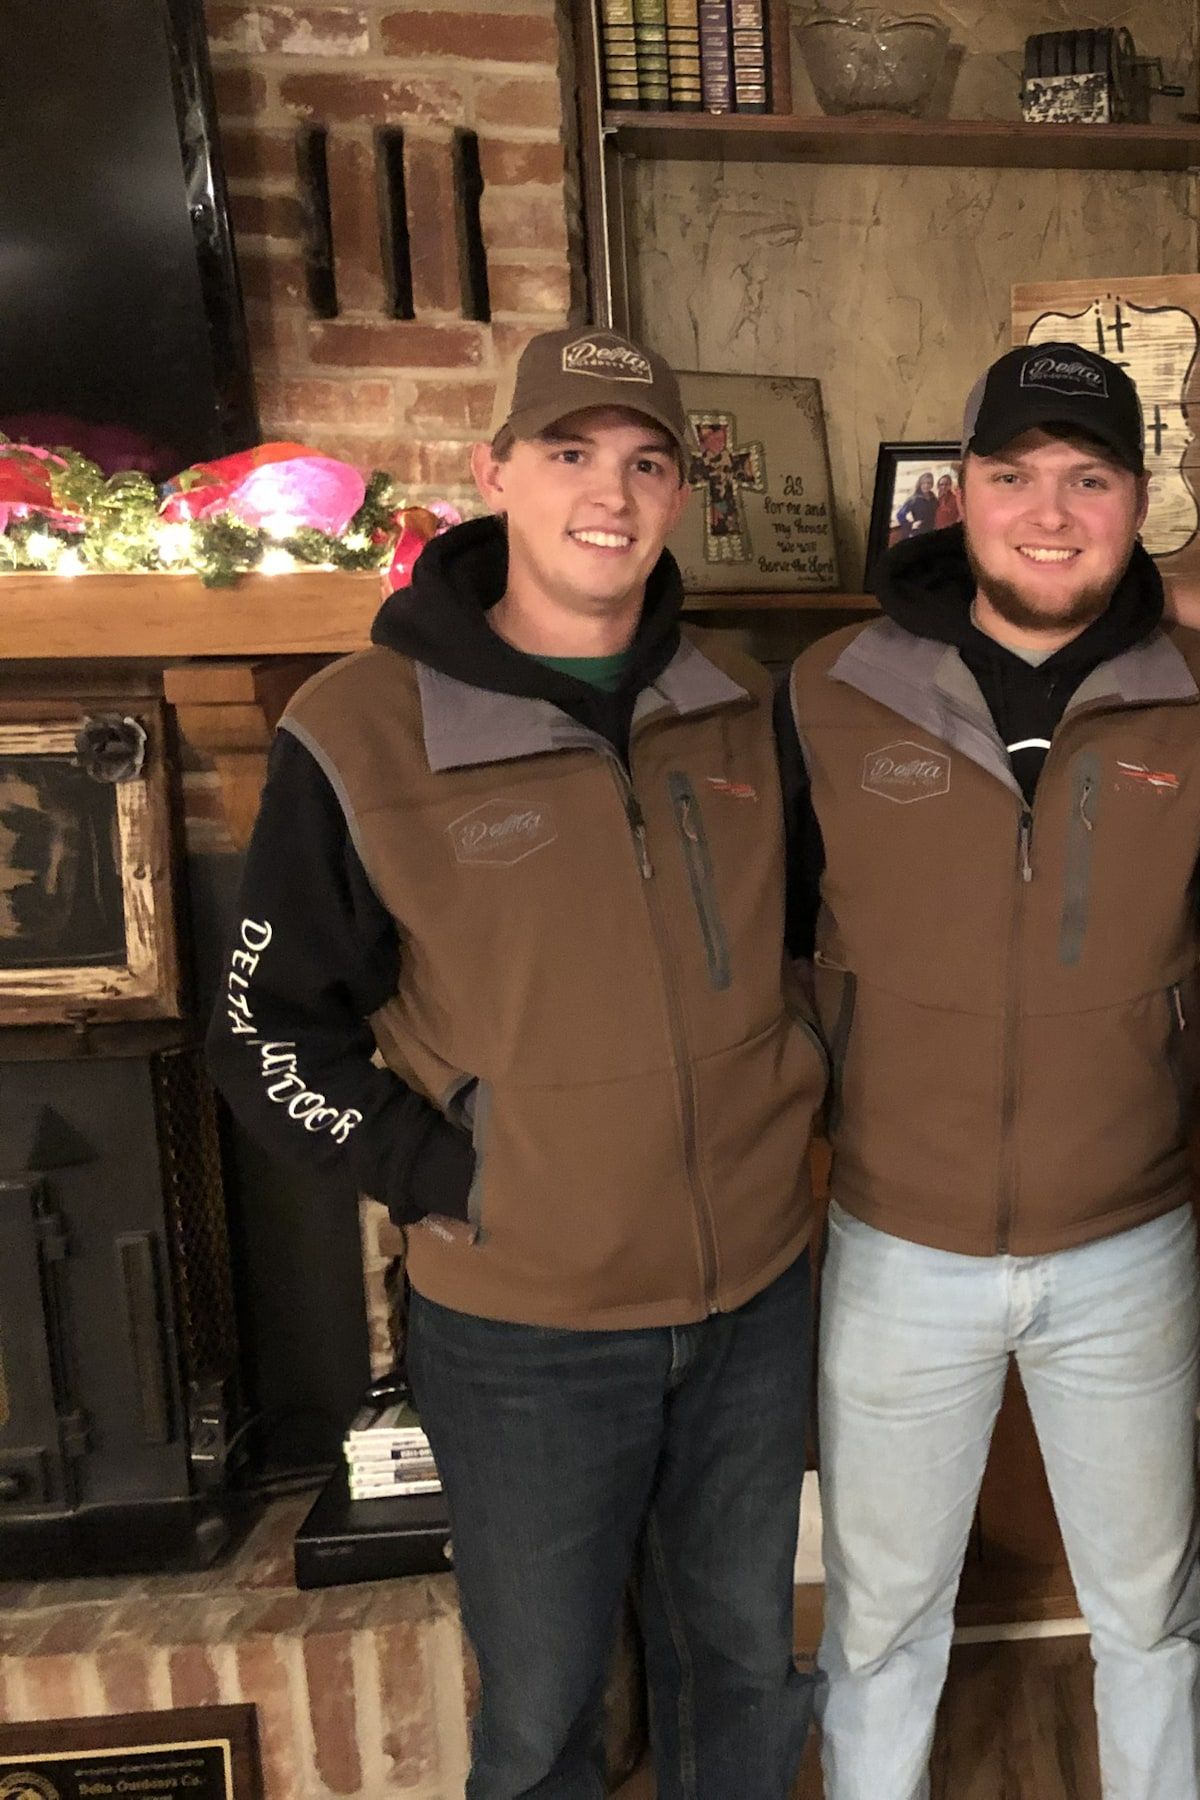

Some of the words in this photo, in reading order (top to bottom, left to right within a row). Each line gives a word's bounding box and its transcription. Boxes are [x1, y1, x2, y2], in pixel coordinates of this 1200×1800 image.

[567, 342, 650, 370] Delta
[1028, 357, 1102, 384] Delta
[805, 502, 827, 517] and
[246, 1039, 364, 1145] UTDOOR
